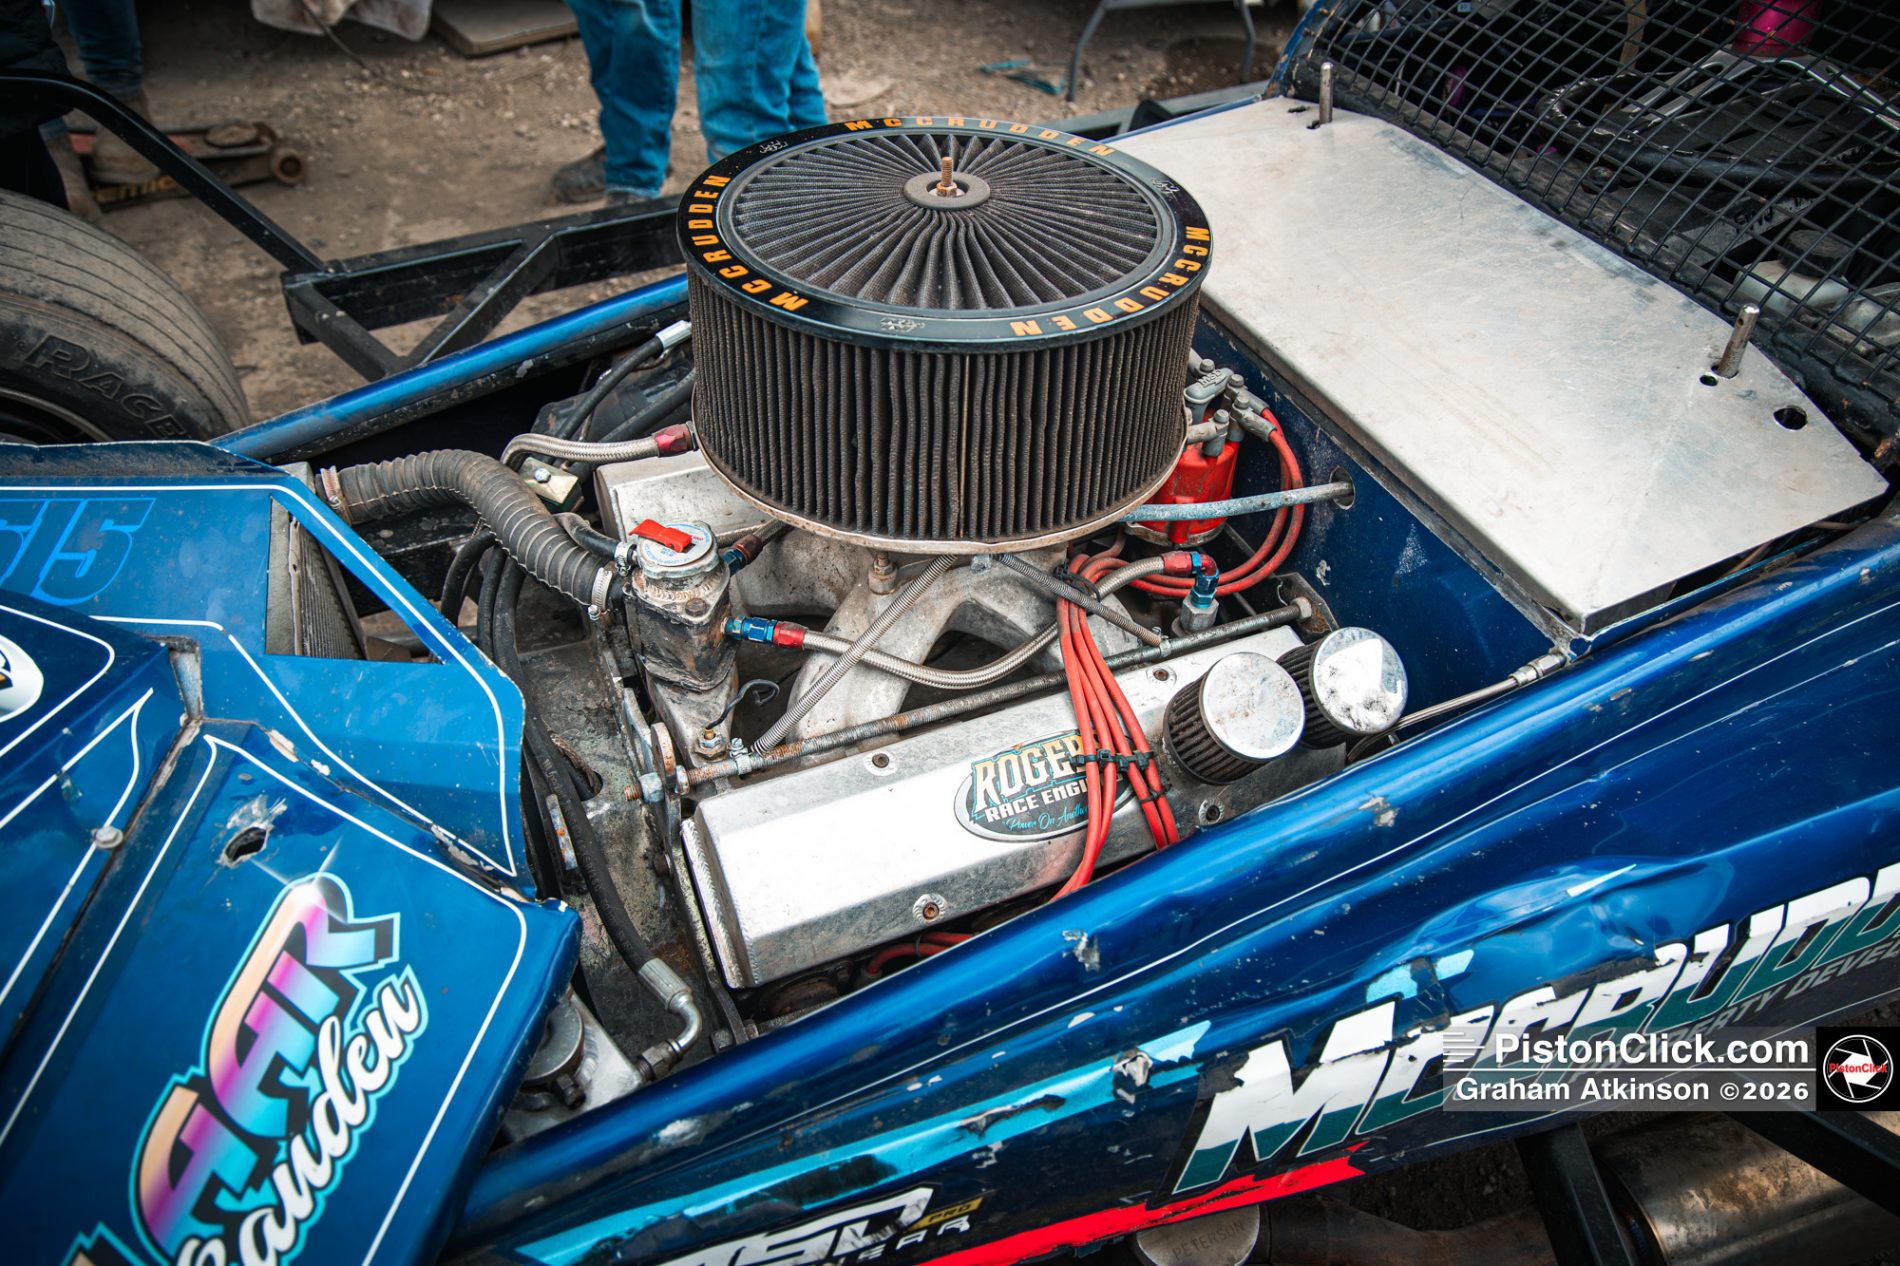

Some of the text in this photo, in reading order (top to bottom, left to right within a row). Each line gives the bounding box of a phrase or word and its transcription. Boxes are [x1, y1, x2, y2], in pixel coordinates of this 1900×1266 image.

[843, 117, 1118, 157] MCCRUDDEN
[688, 175, 809, 312] MCCRUDDEN
[1009, 226, 1211, 337] MCCRUDDEN
[984, 795, 1040, 823] RACE
[927, 1203, 973, 1223] PRO
[1171, 1221, 1246, 1261] PETERSON
